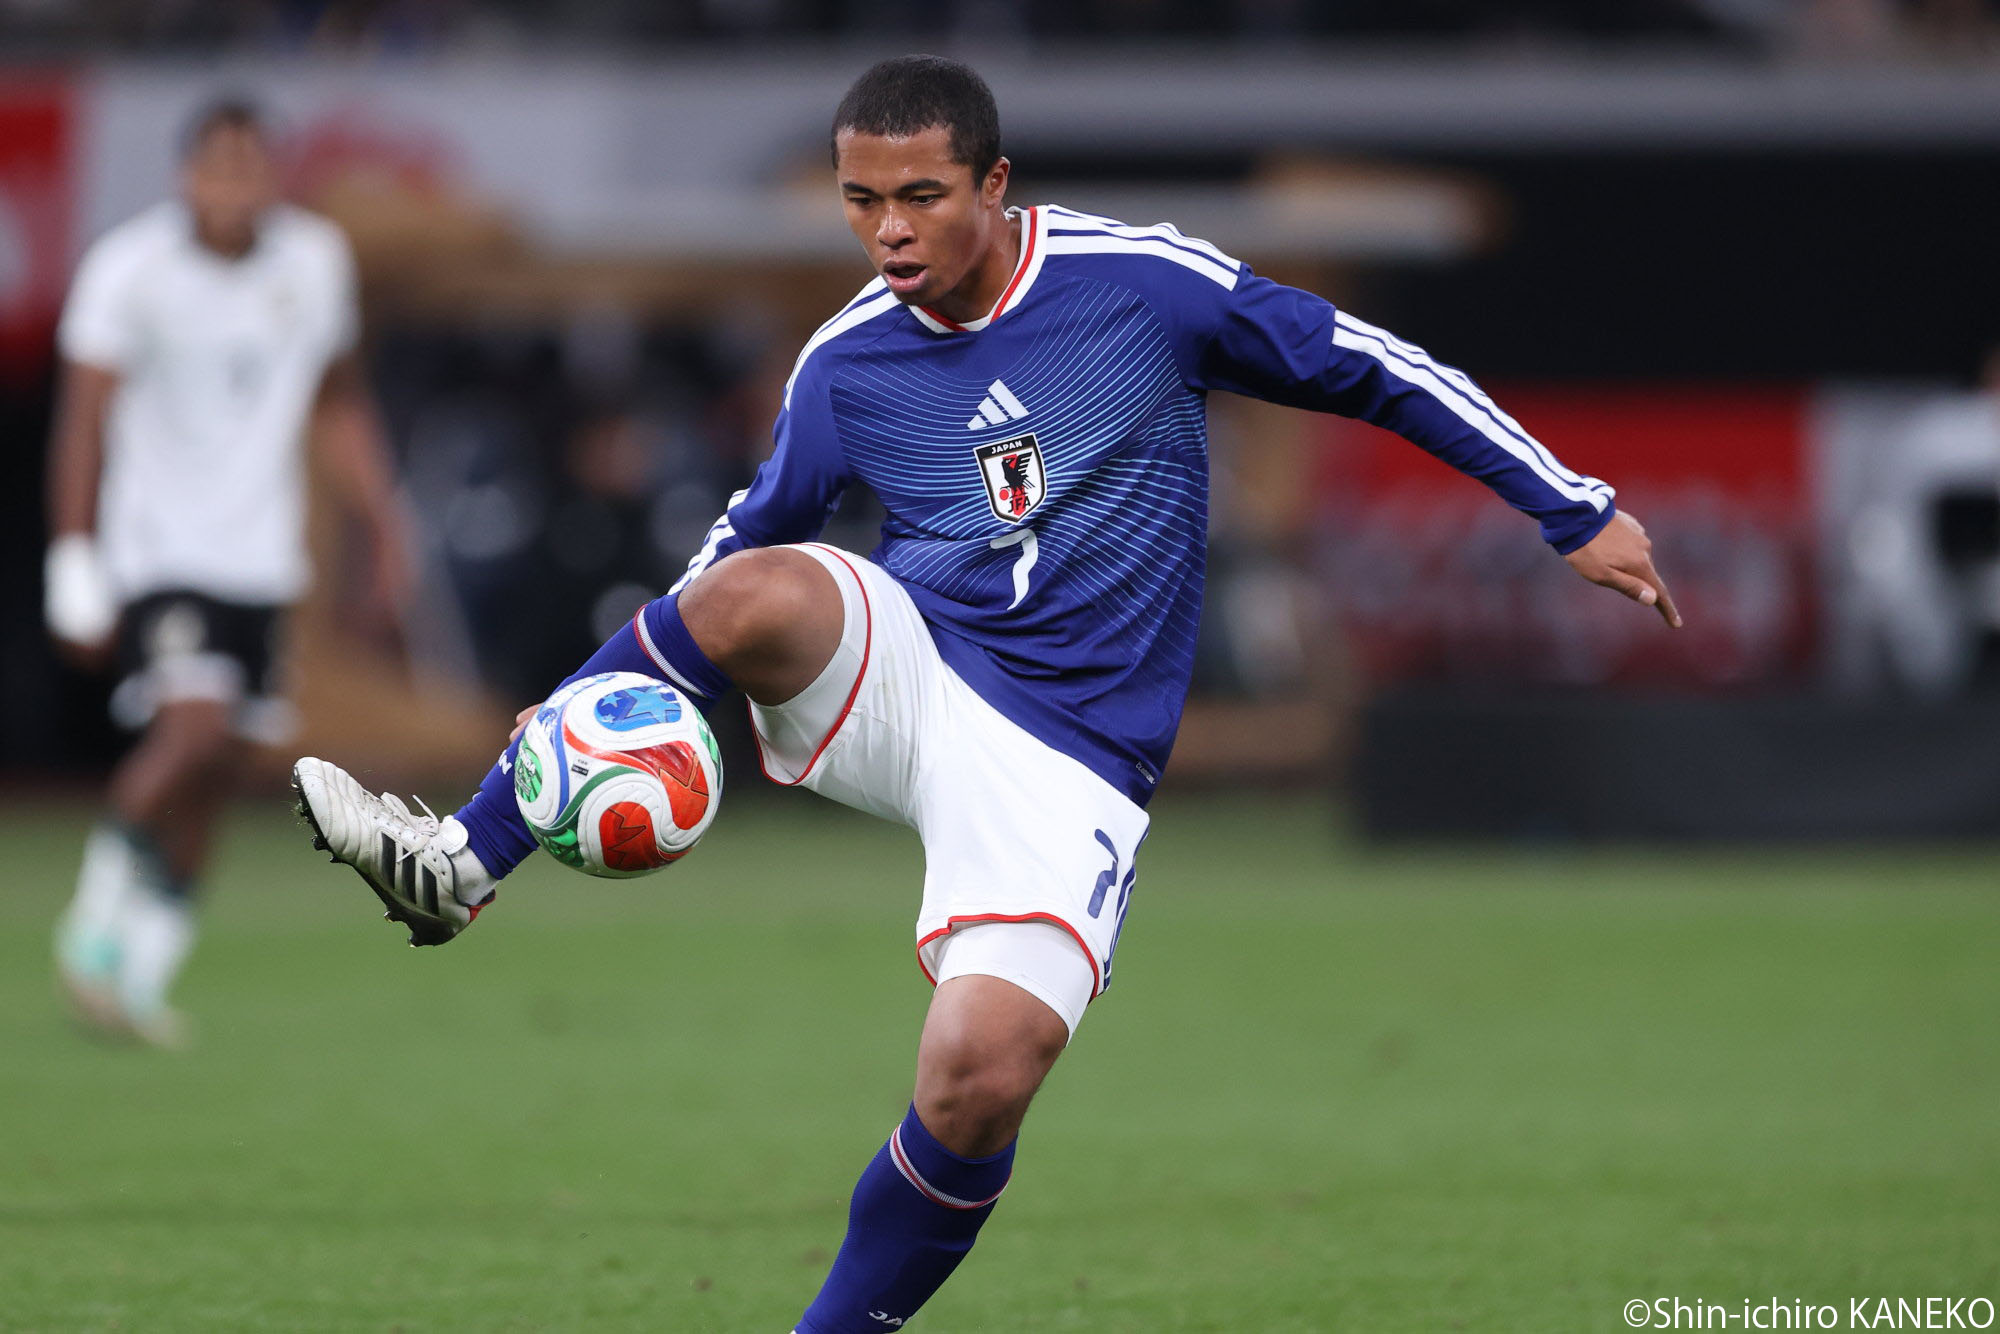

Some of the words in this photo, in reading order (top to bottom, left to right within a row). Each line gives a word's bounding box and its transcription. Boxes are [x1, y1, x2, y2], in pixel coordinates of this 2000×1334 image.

[991, 440, 1023, 455] JAPAN
[1008, 498, 1031, 513] JFA
[989, 528, 1039, 611] 7
[1087, 828, 1119, 919] 7
